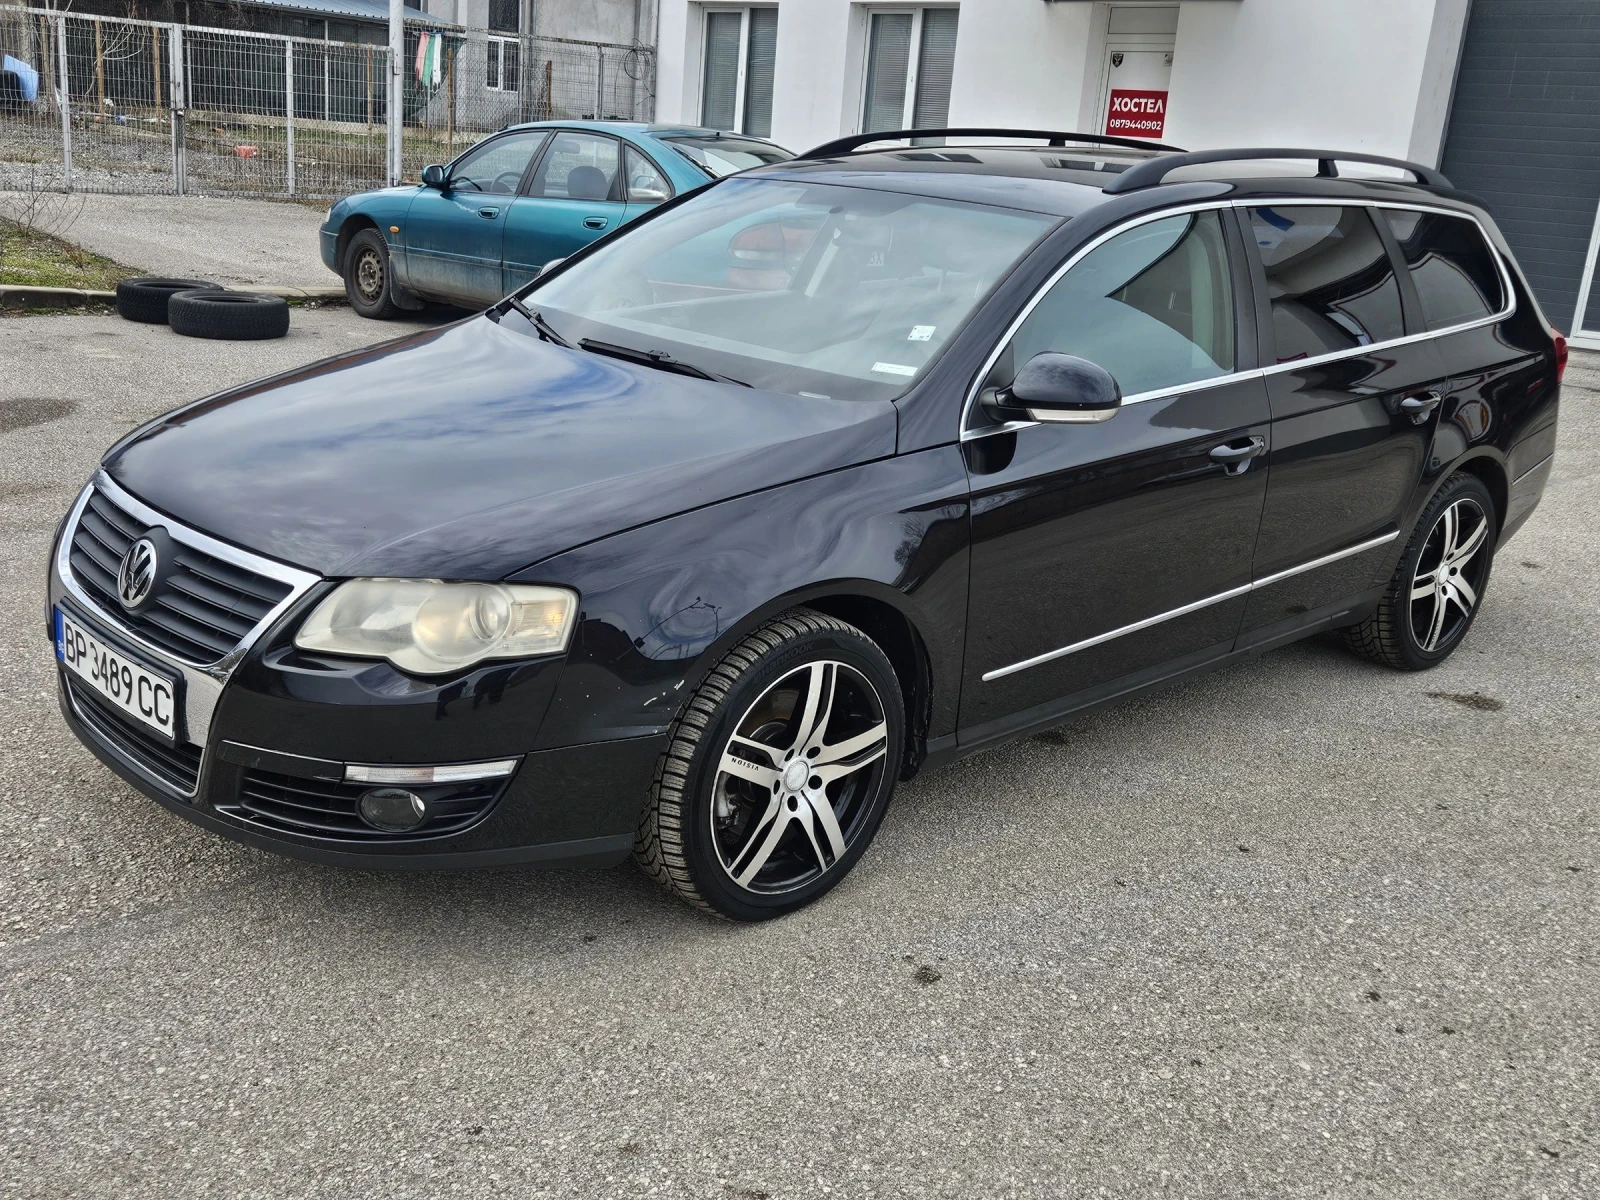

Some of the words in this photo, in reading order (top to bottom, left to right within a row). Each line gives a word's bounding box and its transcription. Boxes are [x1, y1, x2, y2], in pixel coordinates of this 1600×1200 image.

[1112, 97, 1164, 114] ХОСТЕЛ
[1110, 118, 1162, 130] 0879440902
[64, 621, 88, 669] BP
[90, 642, 133, 705] 3489
[138, 675, 171, 726] CC
[730, 757, 760, 772] VISION
